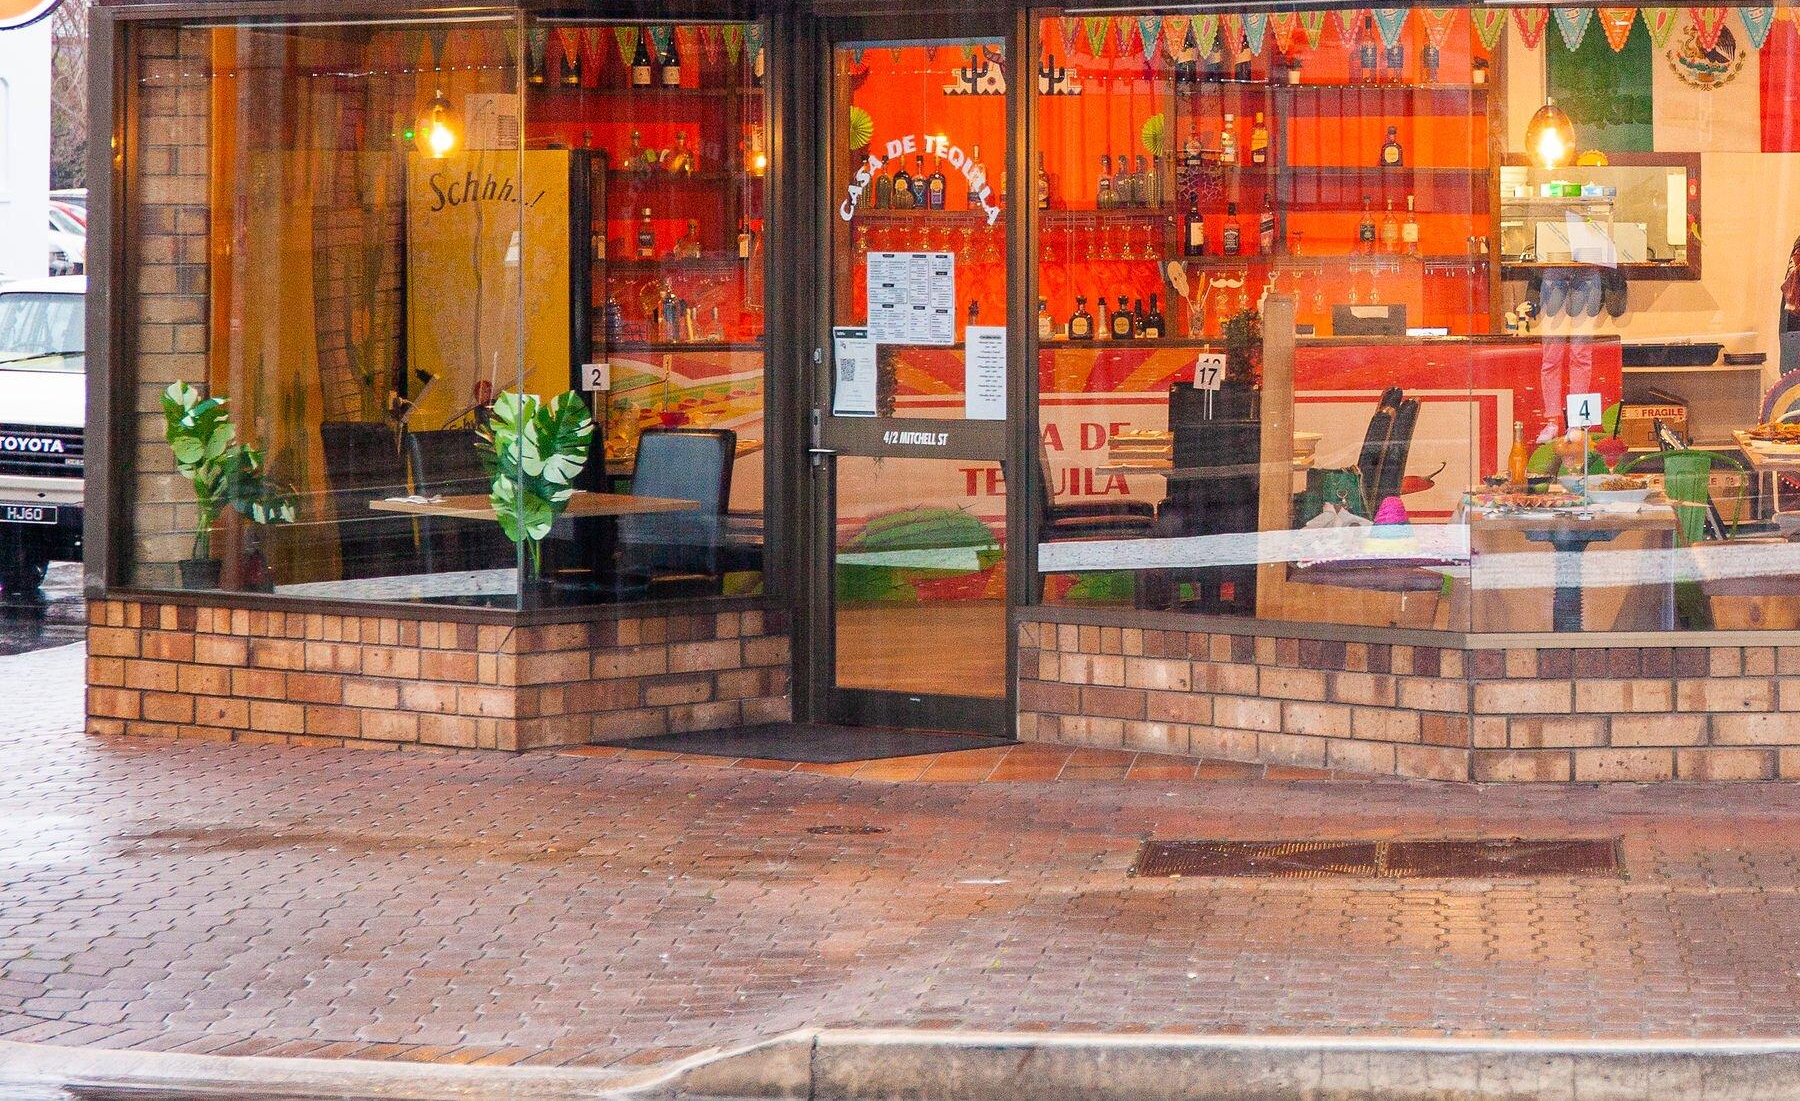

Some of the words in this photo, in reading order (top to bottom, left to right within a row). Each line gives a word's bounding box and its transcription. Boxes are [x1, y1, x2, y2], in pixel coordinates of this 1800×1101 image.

[840, 155, 882, 221] CASA
[886, 135, 916, 159] DE
[924, 134, 1000, 225] TEQUILA
[592, 368, 601, 386] 2
[1199, 367, 1218, 385] 17
[1579, 399, 1590, 420] 4
[1641, 407, 1685, 417] FRAGILE
[883, 431, 899, 444] 4/2
[899, 431, 936, 445] MITCHELL
[937, 433, 949, 446] ST
